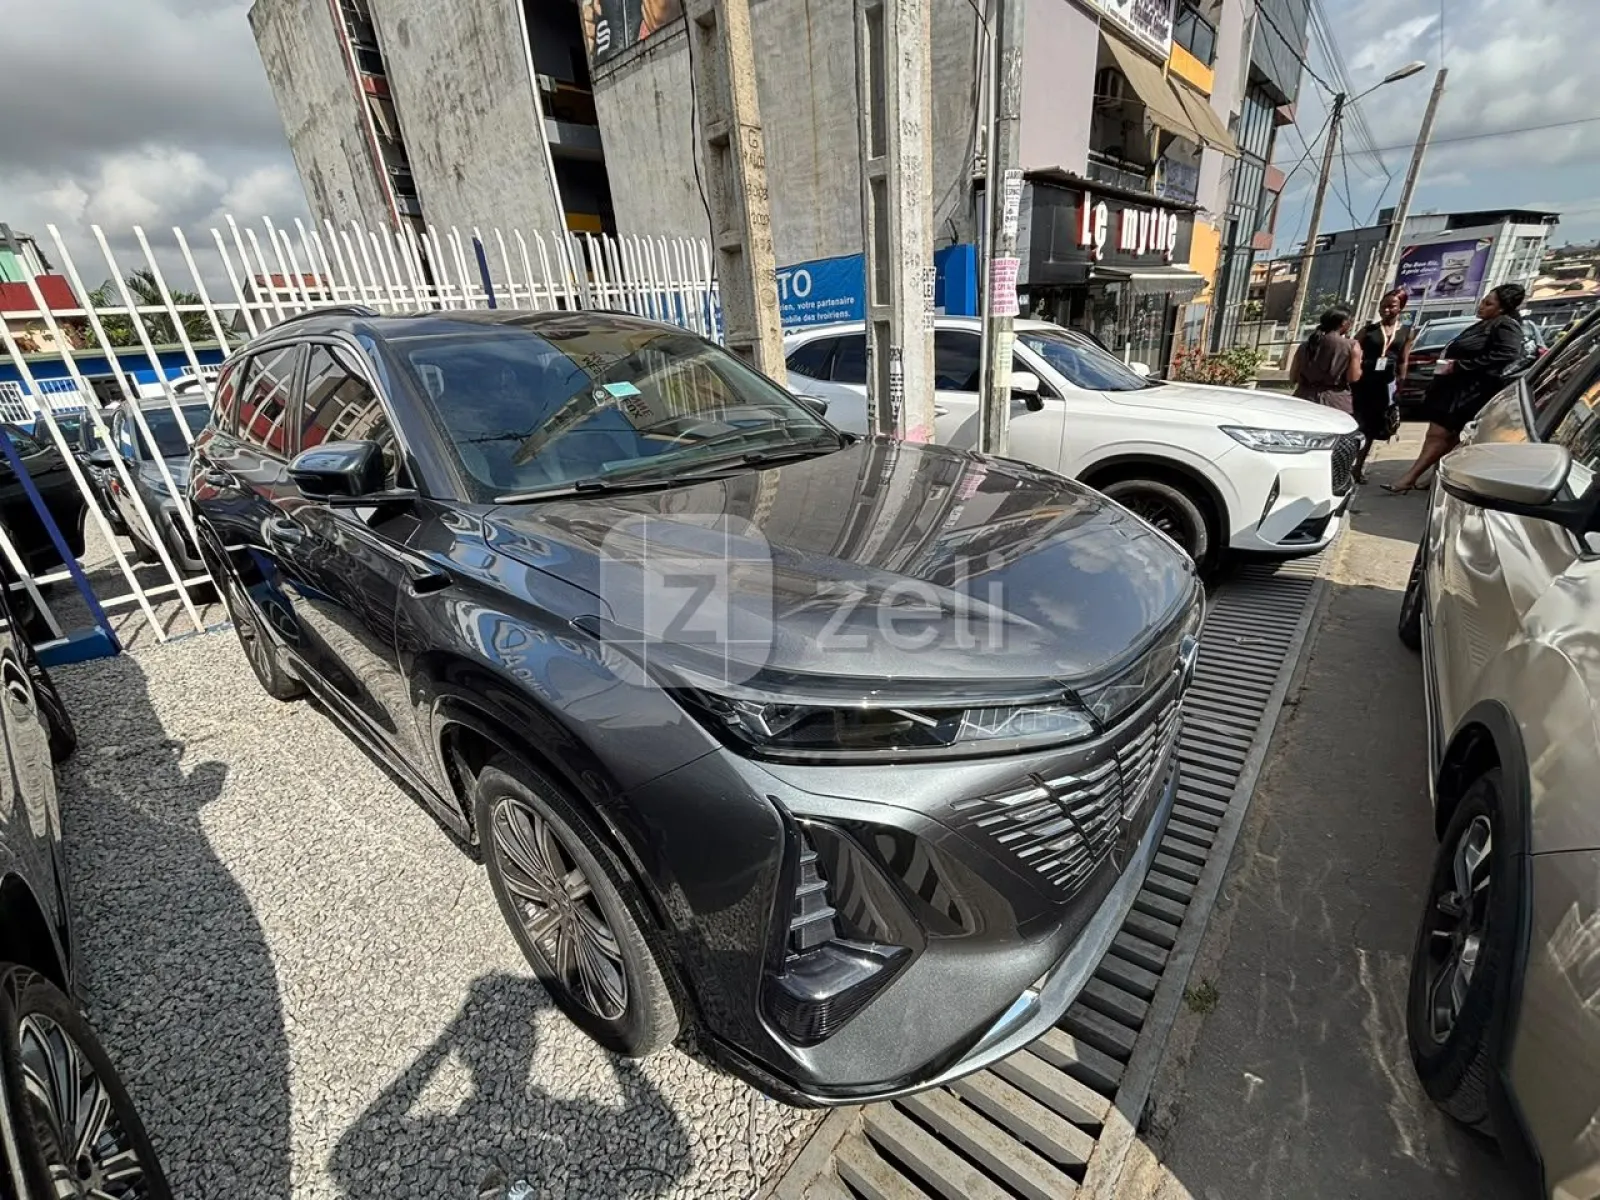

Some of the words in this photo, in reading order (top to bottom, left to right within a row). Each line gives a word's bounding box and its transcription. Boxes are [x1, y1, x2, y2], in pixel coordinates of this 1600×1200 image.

[1081, 190, 1109, 261] Le
[1121, 207, 1178, 261] mythe
[797, 301, 816, 311] votre
[817, 295, 855, 311] partenaire
[803, 313, 816, 323] des
